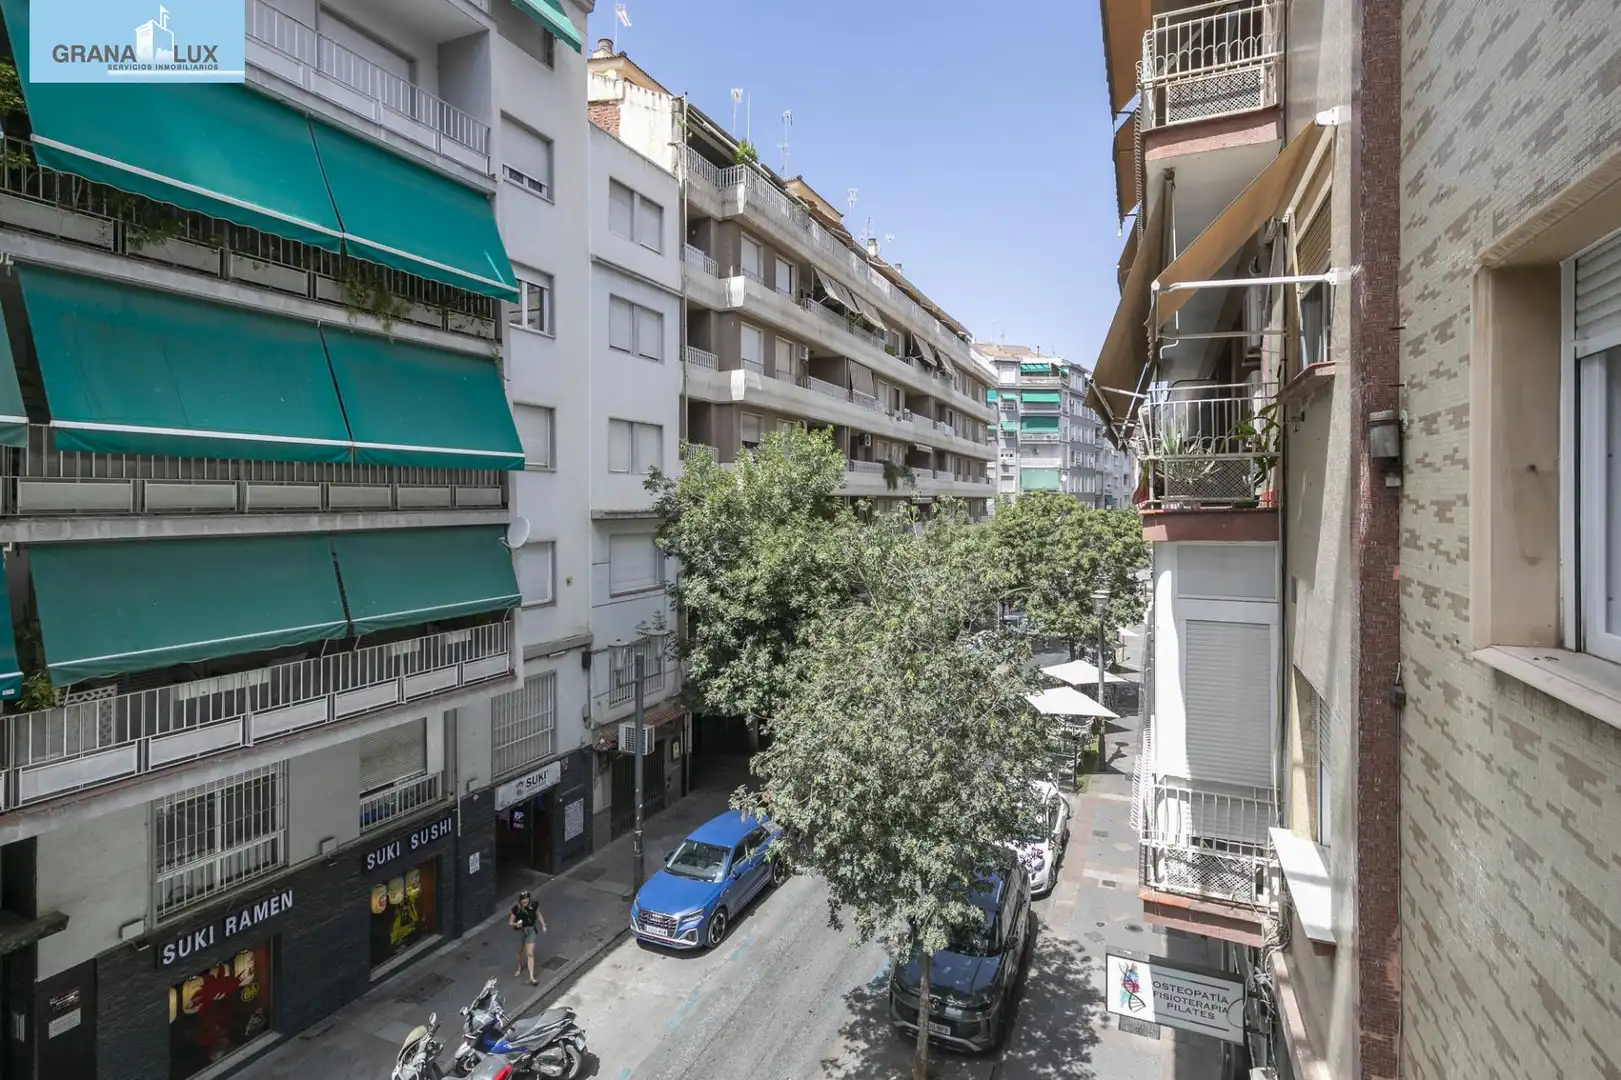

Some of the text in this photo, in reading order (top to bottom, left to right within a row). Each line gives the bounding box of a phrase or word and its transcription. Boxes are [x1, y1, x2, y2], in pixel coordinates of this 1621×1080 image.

[525, 771, 547, 788] SUKI
[367, 817, 452, 870] SUKI SUSHI
[162, 890, 293, 965] SUKI RAMEN
[1153, 980, 1229, 1004] OSTEOPATÍA
[1153, 990, 1229, 1014] FISIOTERAPIA
[1166, 1002, 1215, 1019] PILATES
